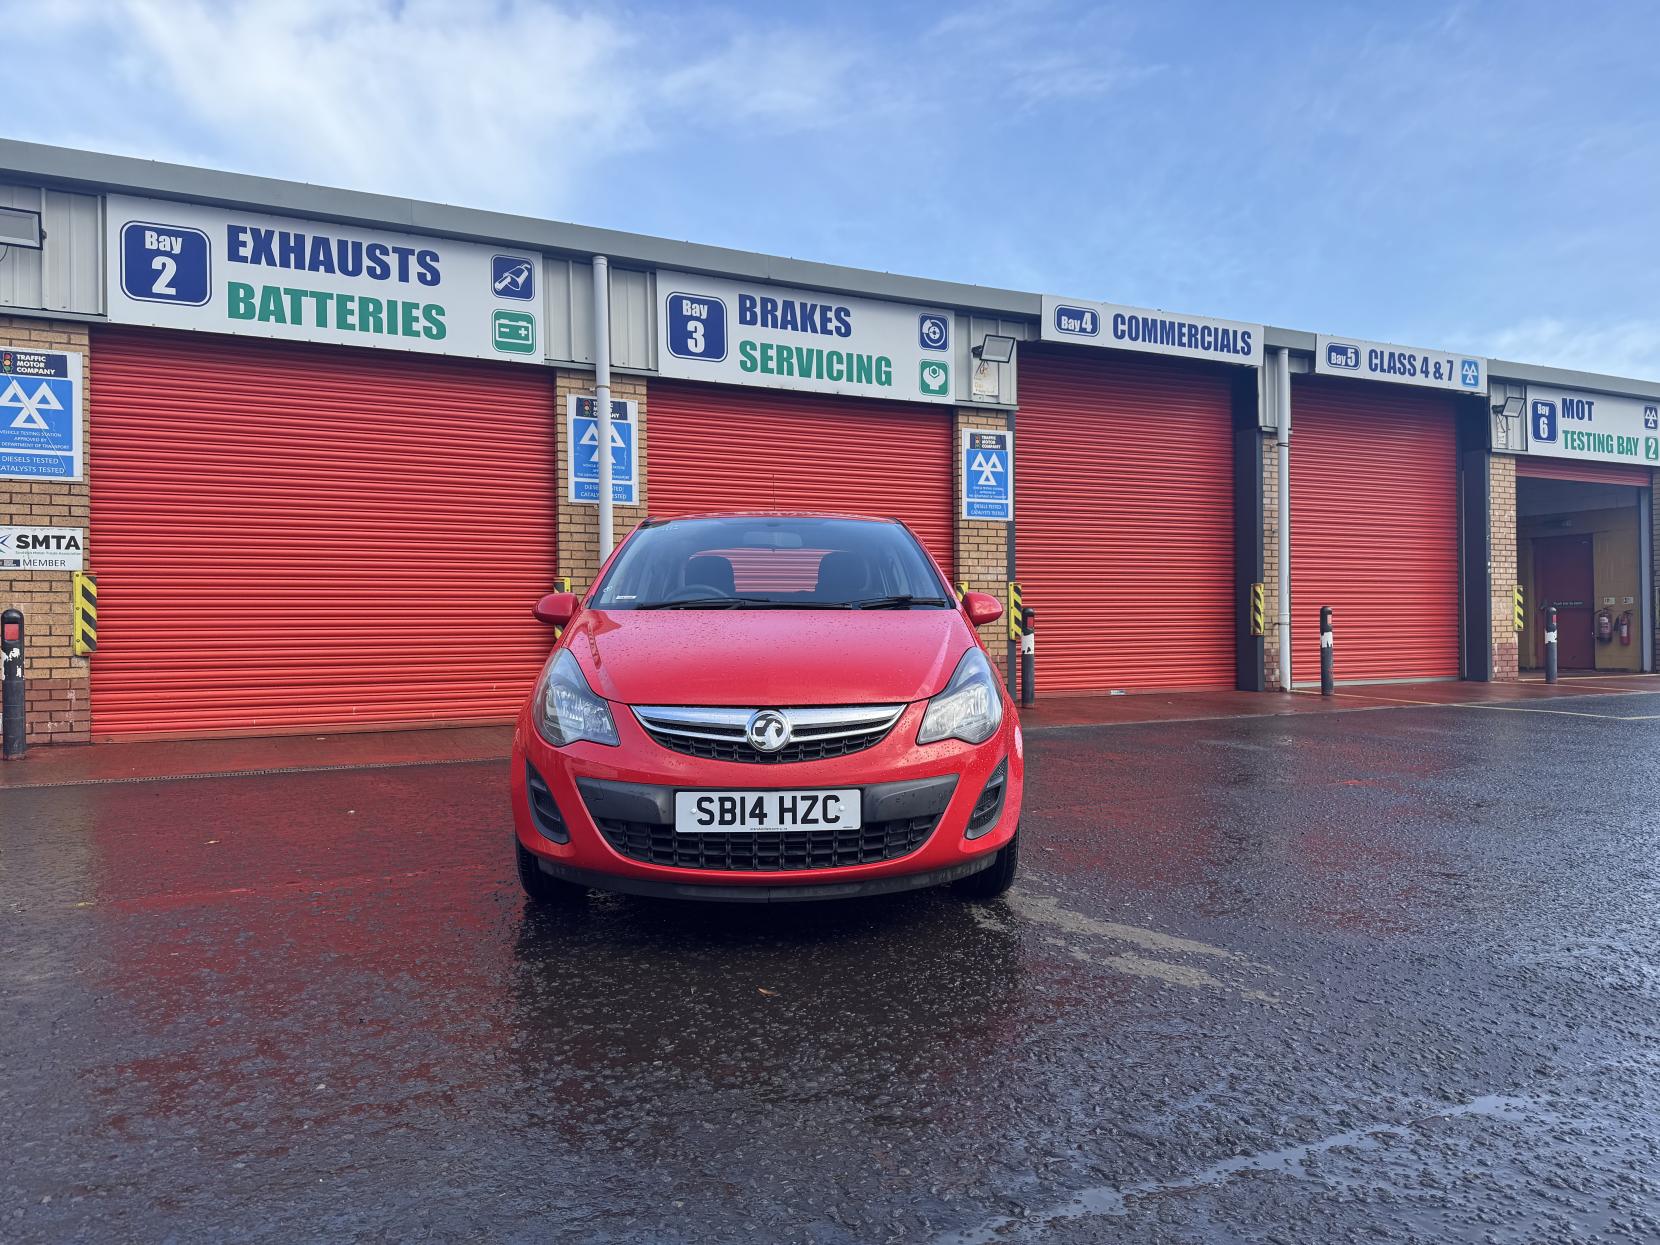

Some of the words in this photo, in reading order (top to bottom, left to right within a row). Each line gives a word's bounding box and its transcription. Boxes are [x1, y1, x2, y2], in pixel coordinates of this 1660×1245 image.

[144, 230, 183, 256] Bay
[226, 224, 441, 286] EXHAUSTS
[151, 256, 177, 296] 2
[227, 280, 447, 340] BATTERIES
[682, 299, 708, 320] Bay
[738, 294, 852, 338] BRAKES
[1061, 316, 1081, 332] Bay
[1082, 312, 1092, 332] 4
[687, 320, 705, 354] 3
[1112, 313, 1252, 356] COMMERCIALS
[739, 340, 893, 386] SERVICING
[1331, 352, 1346, 366] Bay
[1347, 348, 1356, 367] 5
[1368, 348, 1416, 376] CLASS
[1420, 356, 1430, 378] 4
[1434, 362, 1444, 381] &
[1447, 360, 1454, 382] 7
[1538, 404, 1550, 416] Bay
[1562, 398, 1594, 422] MOT
[1540, 416, 1548, 438] 6
[1562, 430, 1614, 454] TESTING
[1616, 436, 1639, 456] BAY
[1648, 438, 1656, 459] 2
[16, 534, 81, 550] SMTA
[696, 796, 768, 826] SB14
[778, 794, 841, 826] HZC
